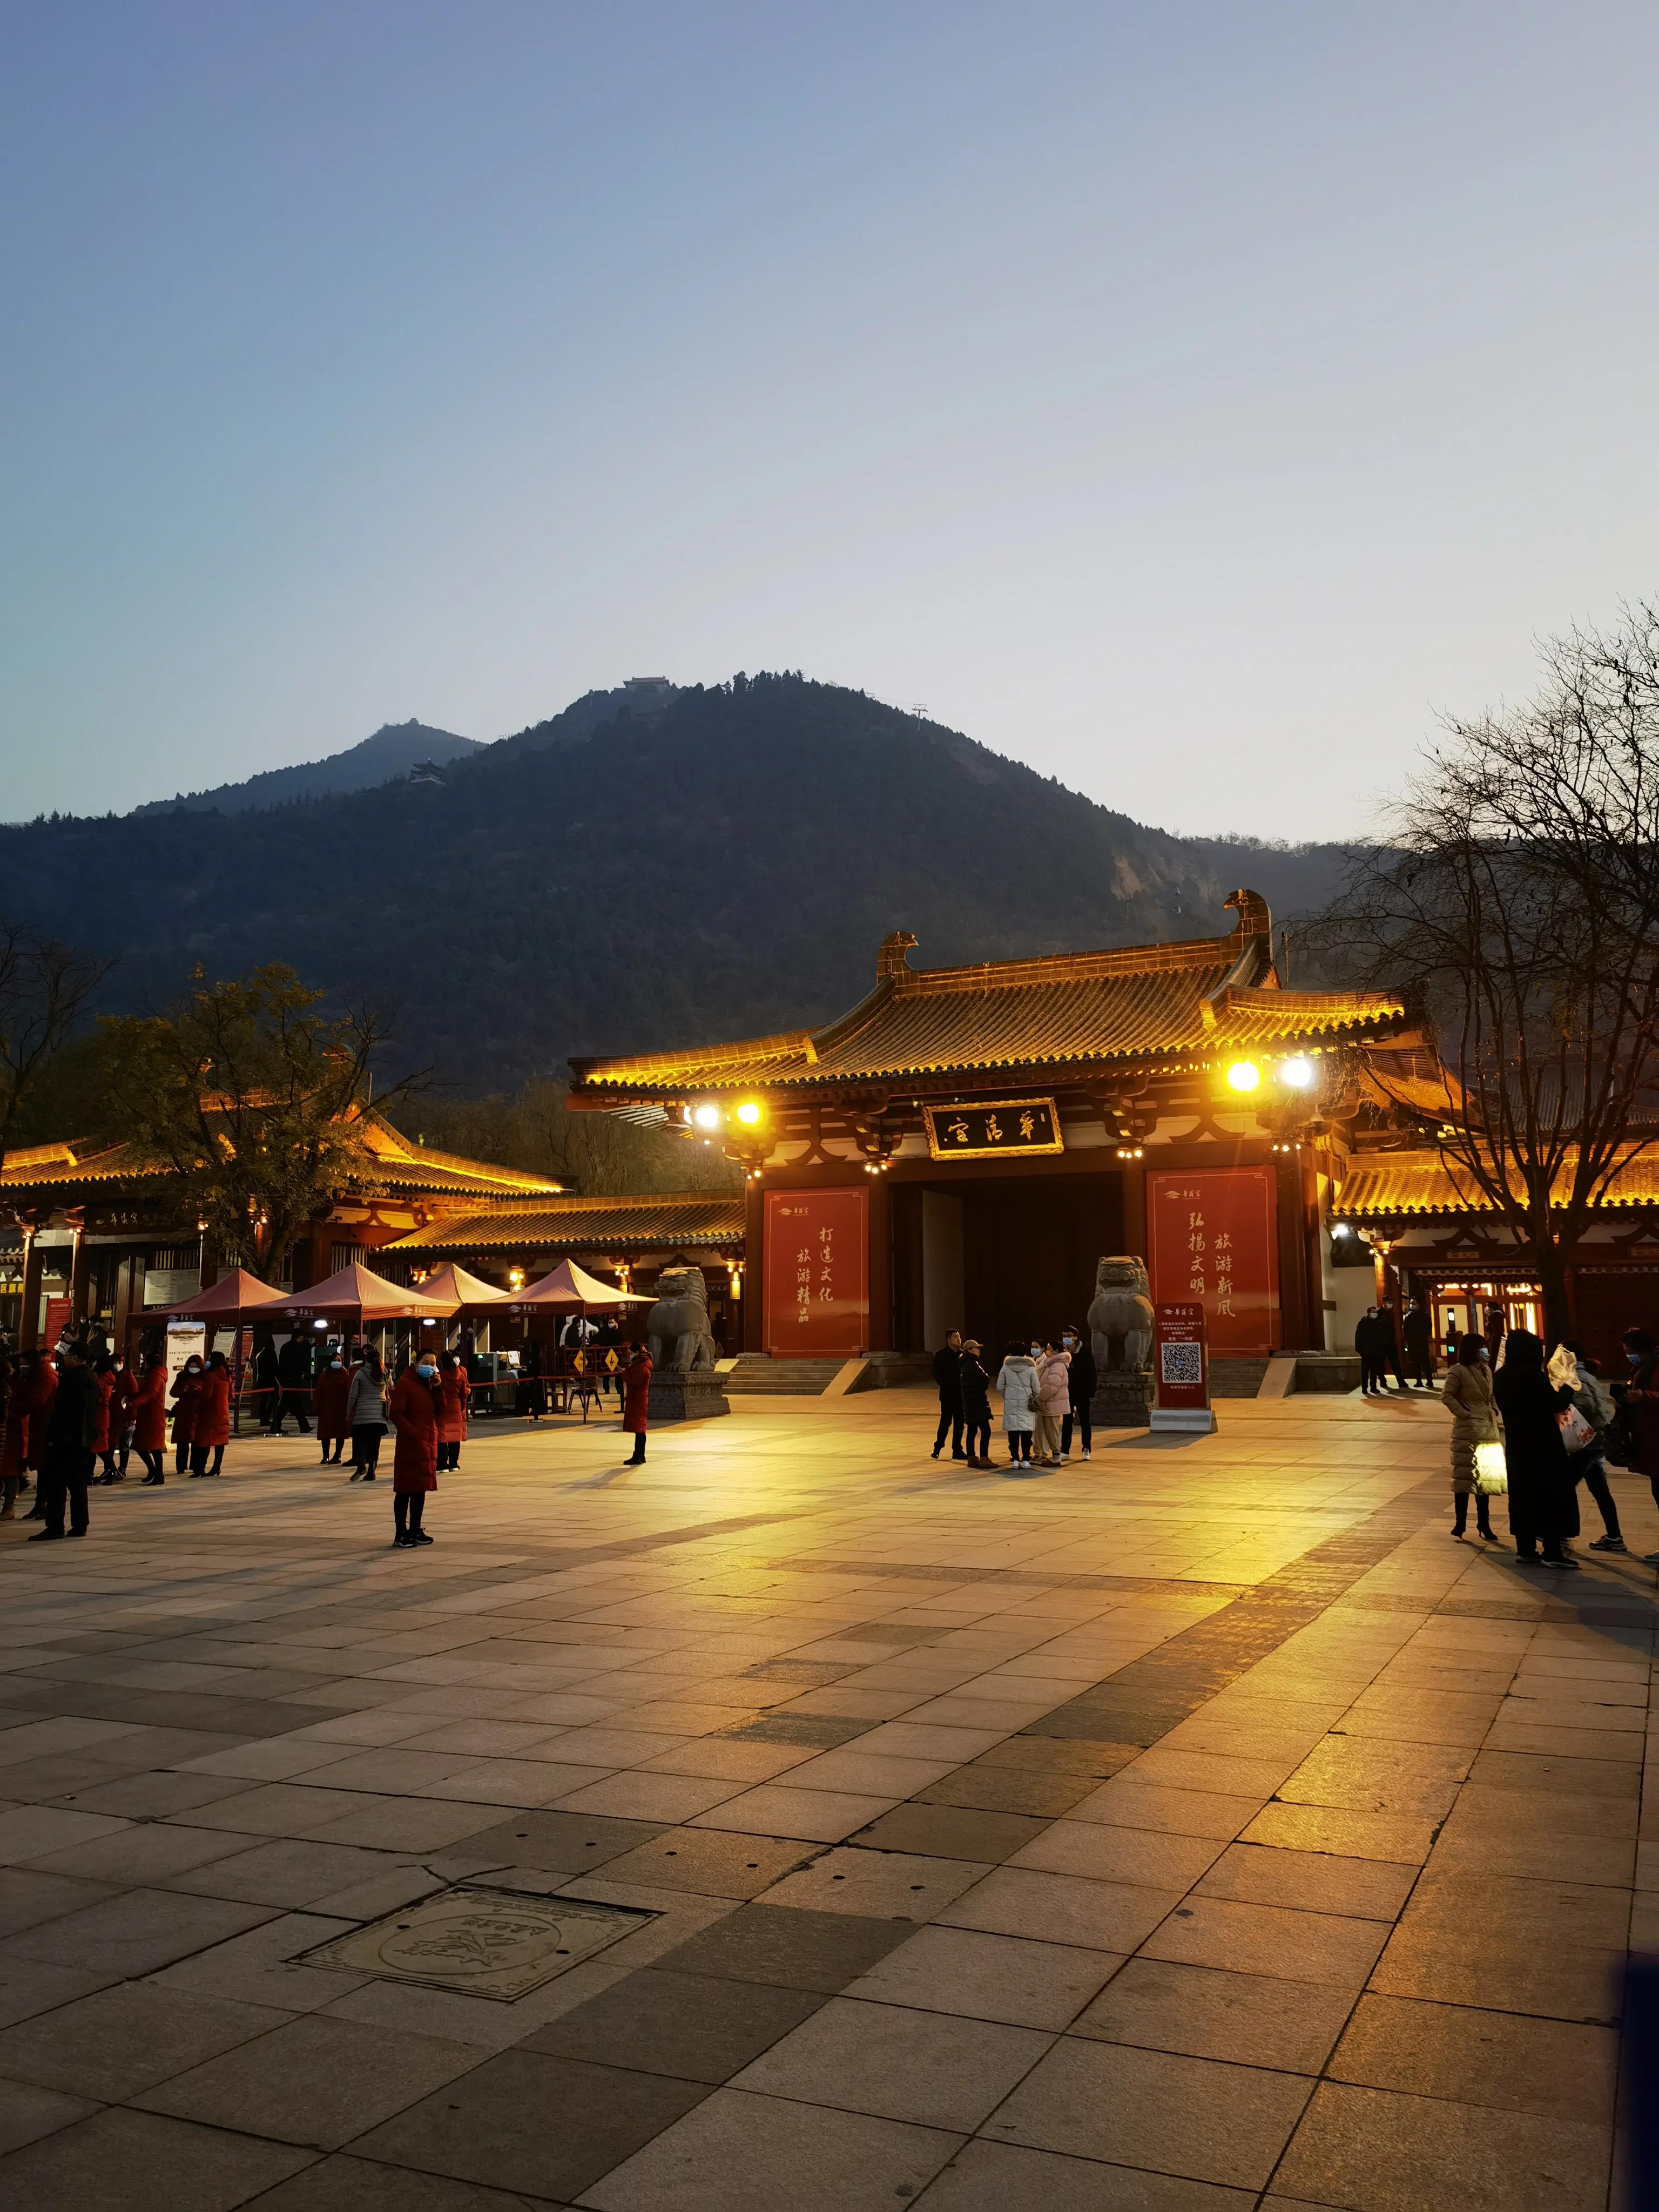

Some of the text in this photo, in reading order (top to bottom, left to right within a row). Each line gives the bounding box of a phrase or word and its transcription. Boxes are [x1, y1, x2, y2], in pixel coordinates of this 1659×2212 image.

[797, 1247, 811, 1323] 旅游精品
[819, 1226, 834, 1302] 打造文化
